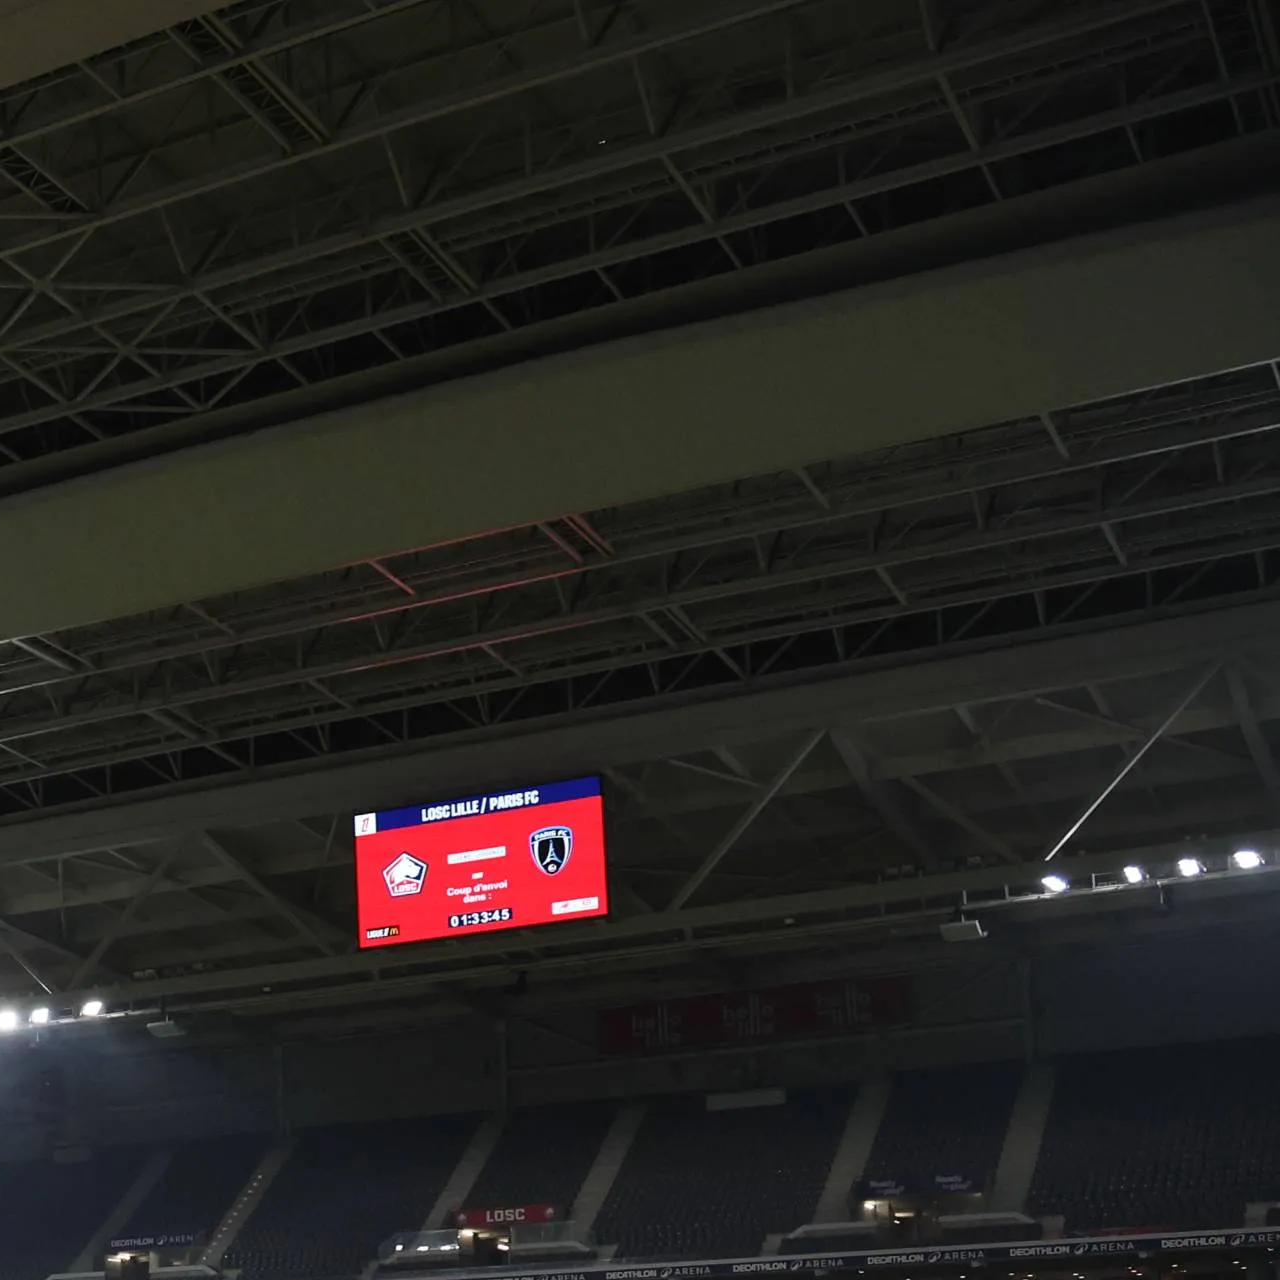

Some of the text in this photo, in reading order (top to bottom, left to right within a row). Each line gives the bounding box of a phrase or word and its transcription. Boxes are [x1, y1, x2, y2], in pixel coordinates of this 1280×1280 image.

[421, 806, 450, 822] LOSC
[451, 800, 480, 816] LILLE
[490, 793, 524, 812] PARIS
[524, 790, 539, 805] FC
[534, 829, 569, 841] PARIS FC
[447, 880, 508, 898] Coup d'envoi
[450, 908, 510, 928] 01:33:45
[486, 1208, 525, 1222] LOSC
[1009, 1241, 1135, 1258] DECATHLON ARENA
[1161, 1235, 1226, 1250] DECATHLON
[732, 1258, 844, 1273] DECATHLON ARENA
[867, 1249, 985, 1266] DECATHLON ARENA
[605, 1266, 711, 1280] DECATHLON ARENA
